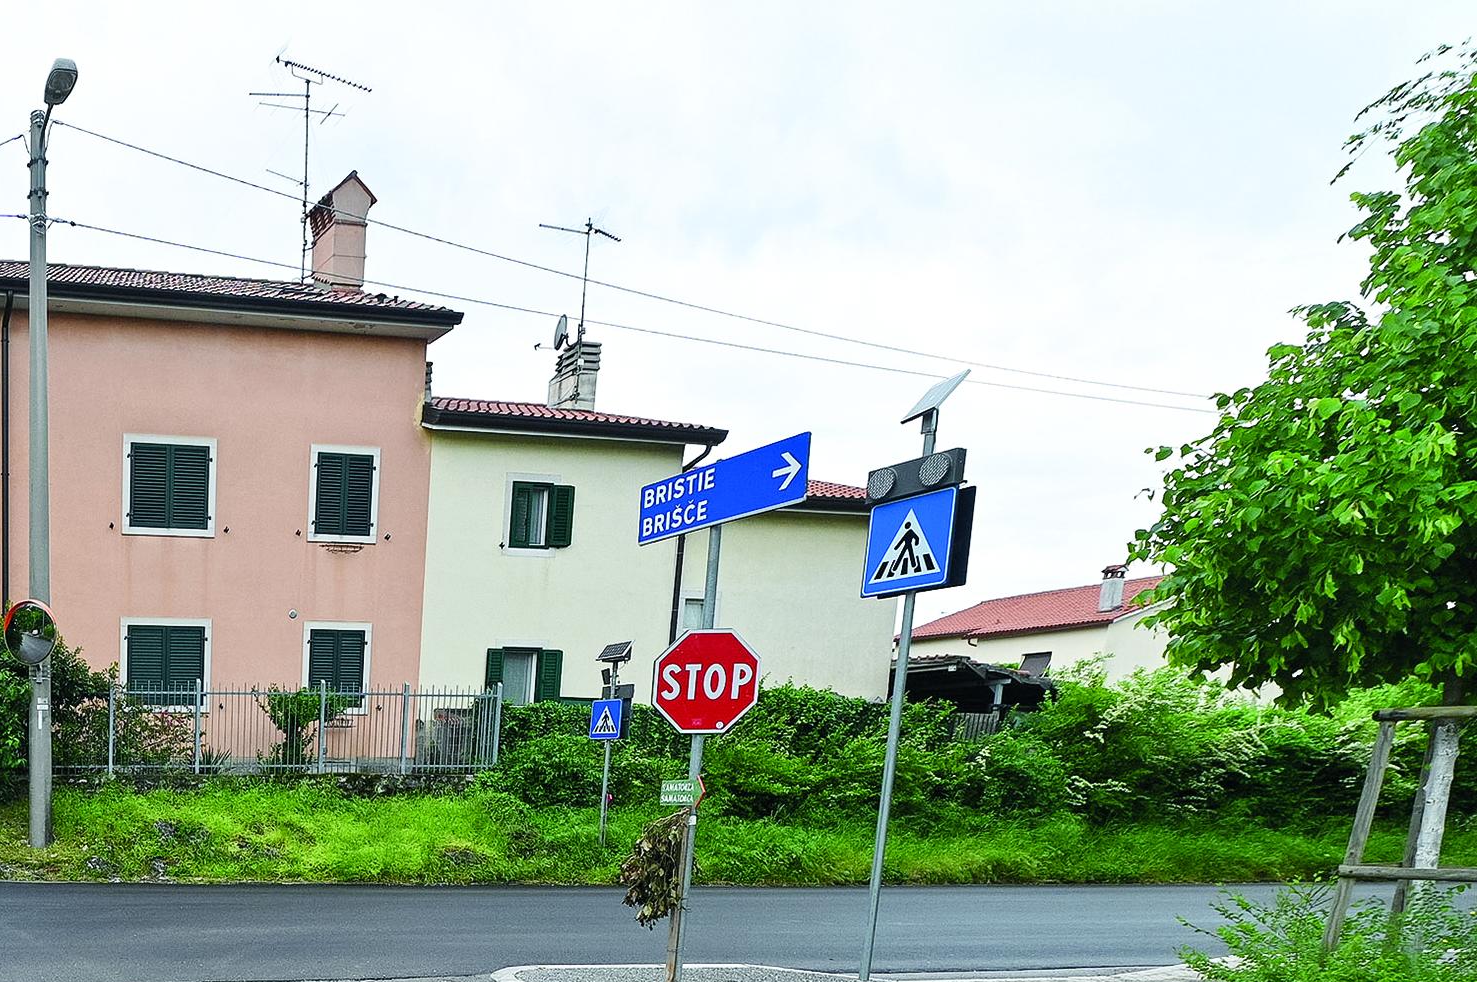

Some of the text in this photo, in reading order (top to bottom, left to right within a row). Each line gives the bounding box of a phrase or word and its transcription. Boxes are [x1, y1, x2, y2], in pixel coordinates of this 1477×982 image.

[643, 467, 716, 509] BRISTIE
[642, 499, 709, 537] BRIŠČE
[660, 663, 753, 701] STOP
